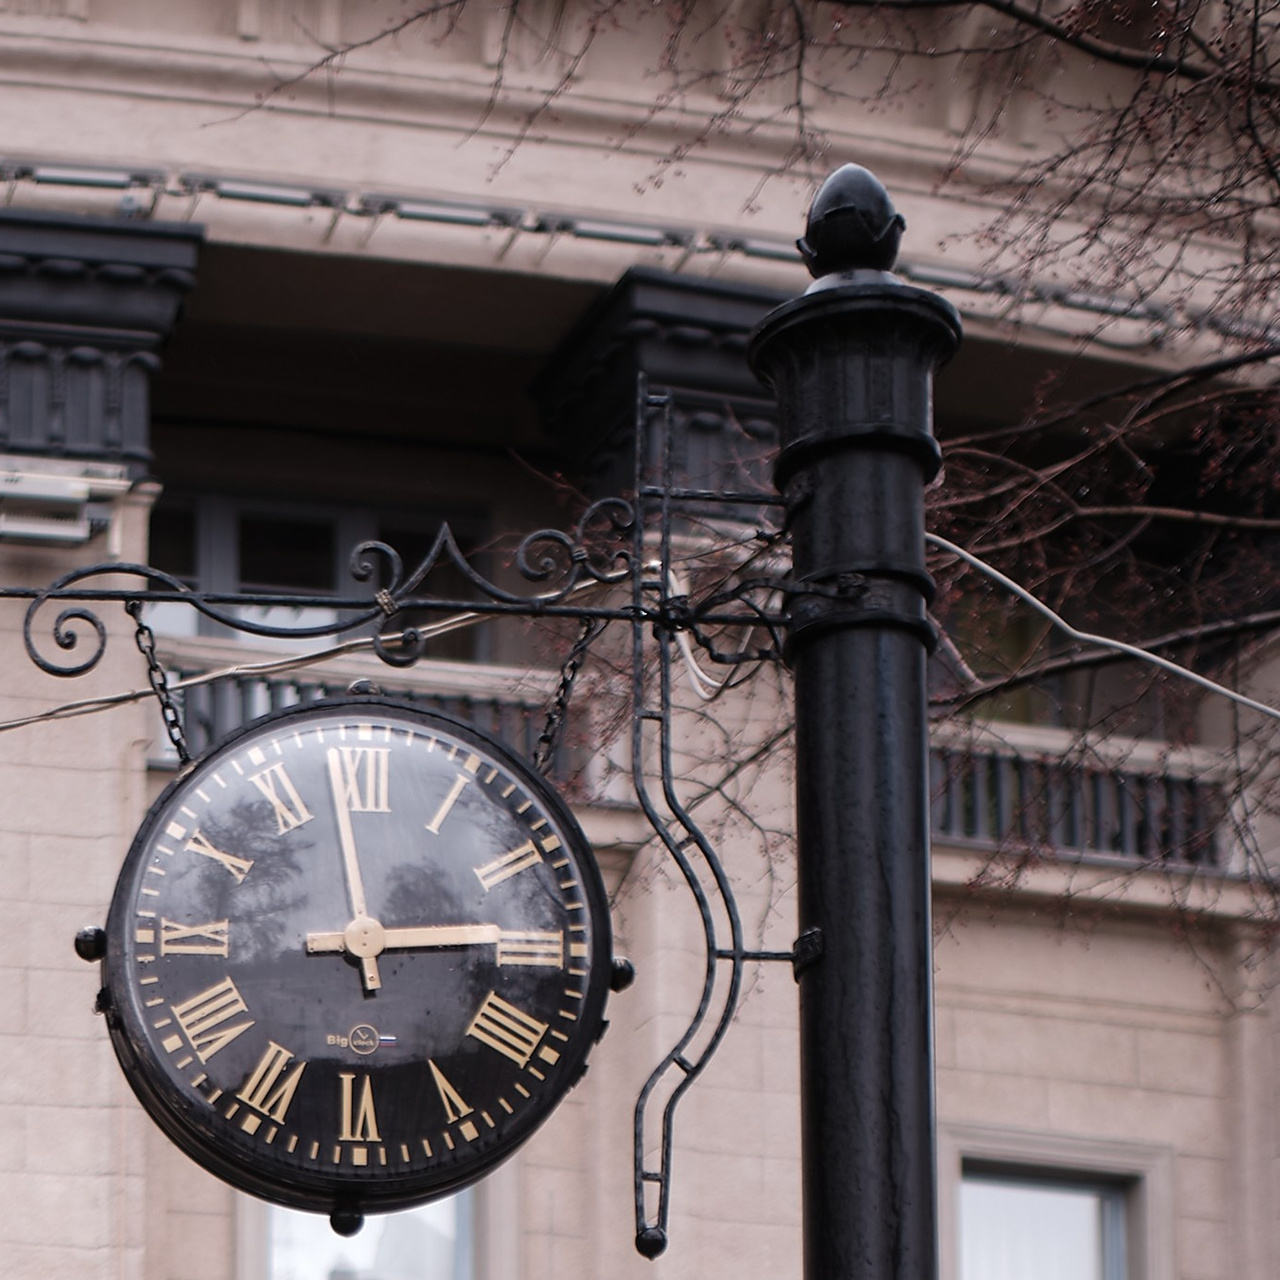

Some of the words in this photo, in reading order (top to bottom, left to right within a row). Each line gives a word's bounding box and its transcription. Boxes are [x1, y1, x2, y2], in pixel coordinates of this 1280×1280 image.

[249, 762, 314, 835] XI
[338, 747, 392, 813] XII
[184, 830, 254, 883] X
[472, 839, 543, 891] II
[161, 917, 228, 958] IX
[496, 930, 564, 970] III
[170, 976, 256, 1065] VIII
[327, 1035, 348, 1048] Big
[465, 991, 549, 1068] IIII
[236, 1041, 308, 1125] VII
[339, 1074, 381, 1142] VI
[428, 1059, 474, 1125] V
